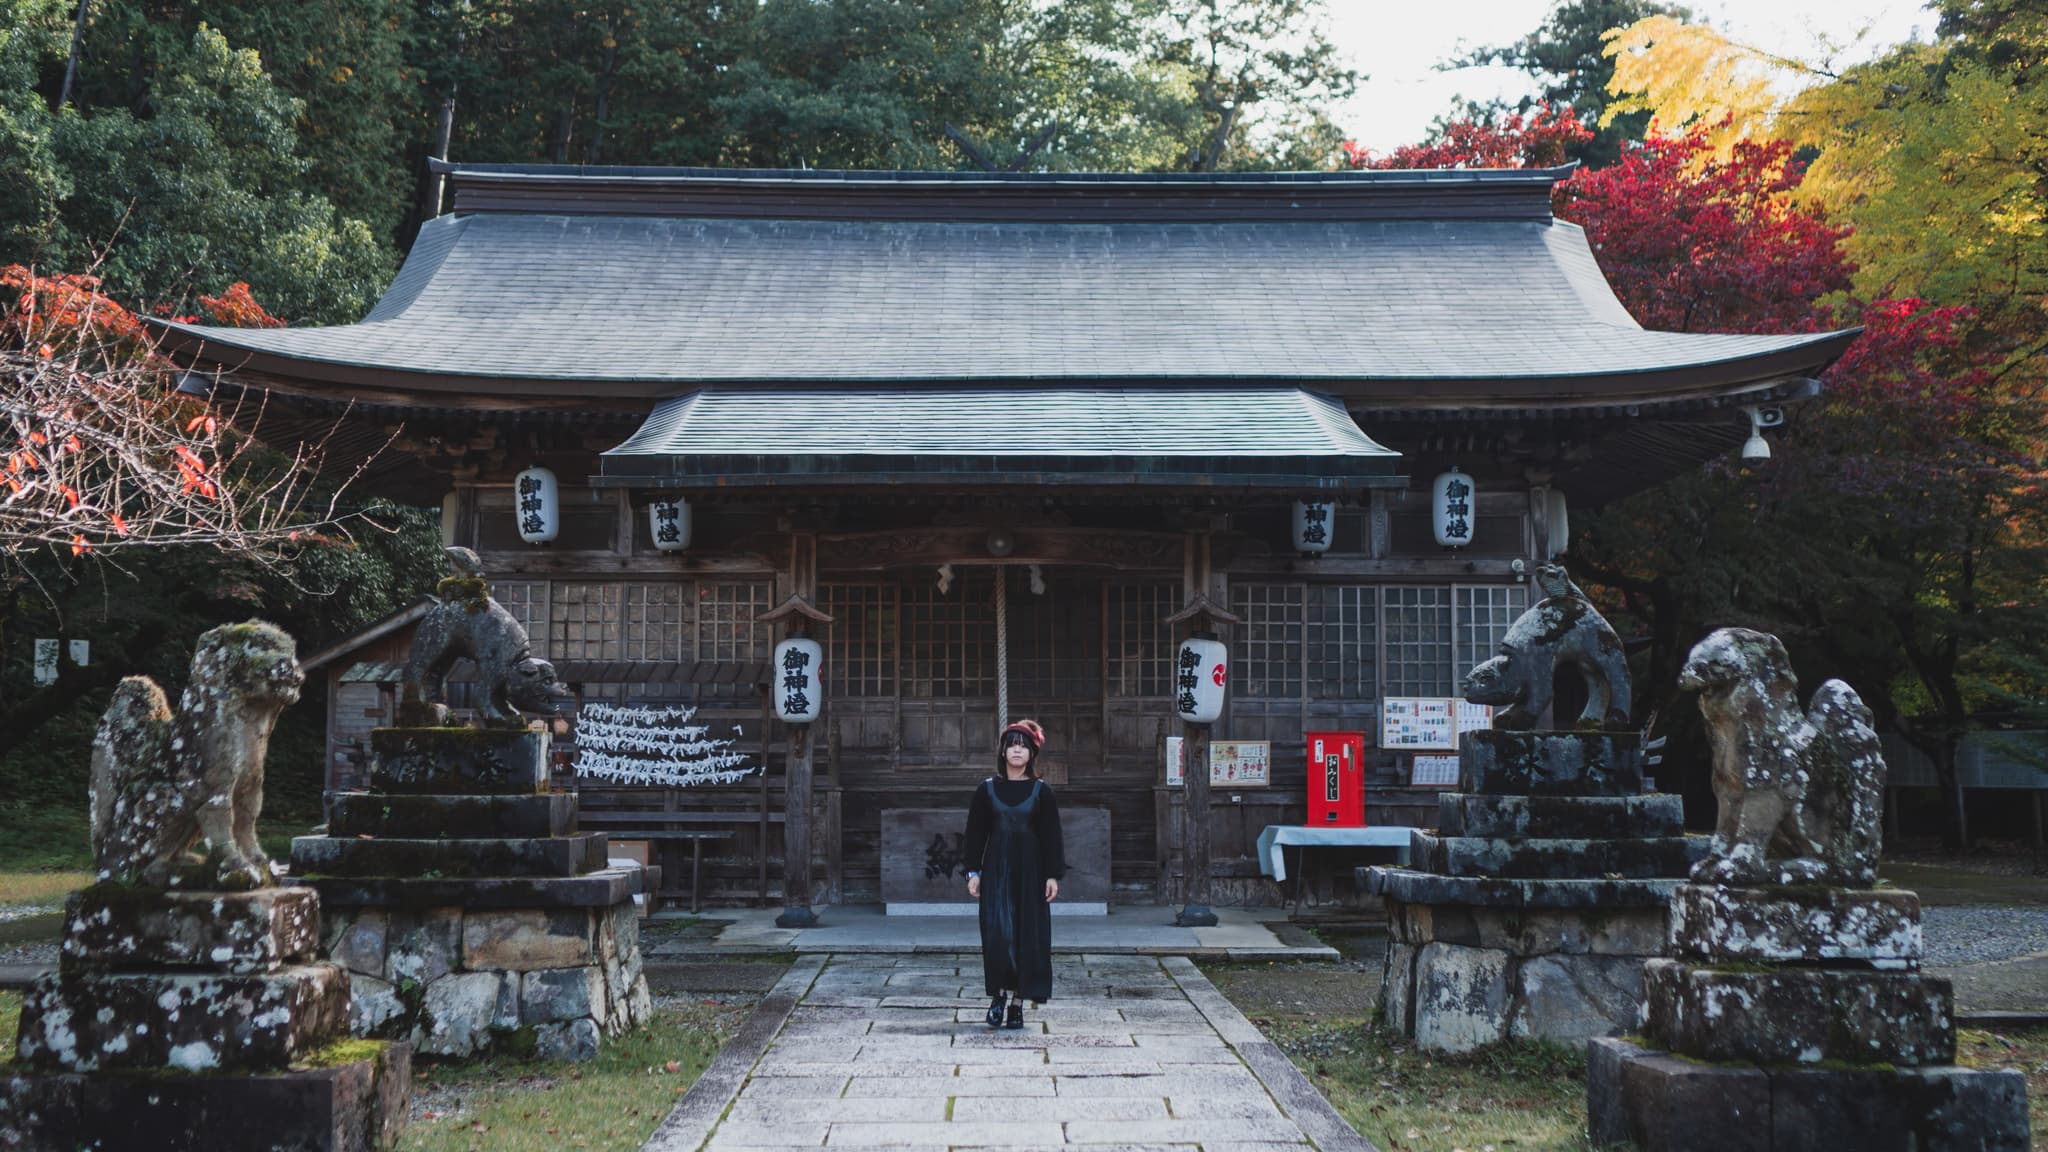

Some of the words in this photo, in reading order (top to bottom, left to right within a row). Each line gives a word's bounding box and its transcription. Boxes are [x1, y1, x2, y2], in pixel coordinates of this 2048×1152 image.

[519, 475, 545, 535] 御神燈
[654, 496, 681, 543] 神燈
[1445, 479, 1469, 539] 御神燈
[782, 646, 810, 715] 御神燈
[1178, 646, 1202, 715] 御神燈
[1327, 755, 1337, 799] おみくじ
